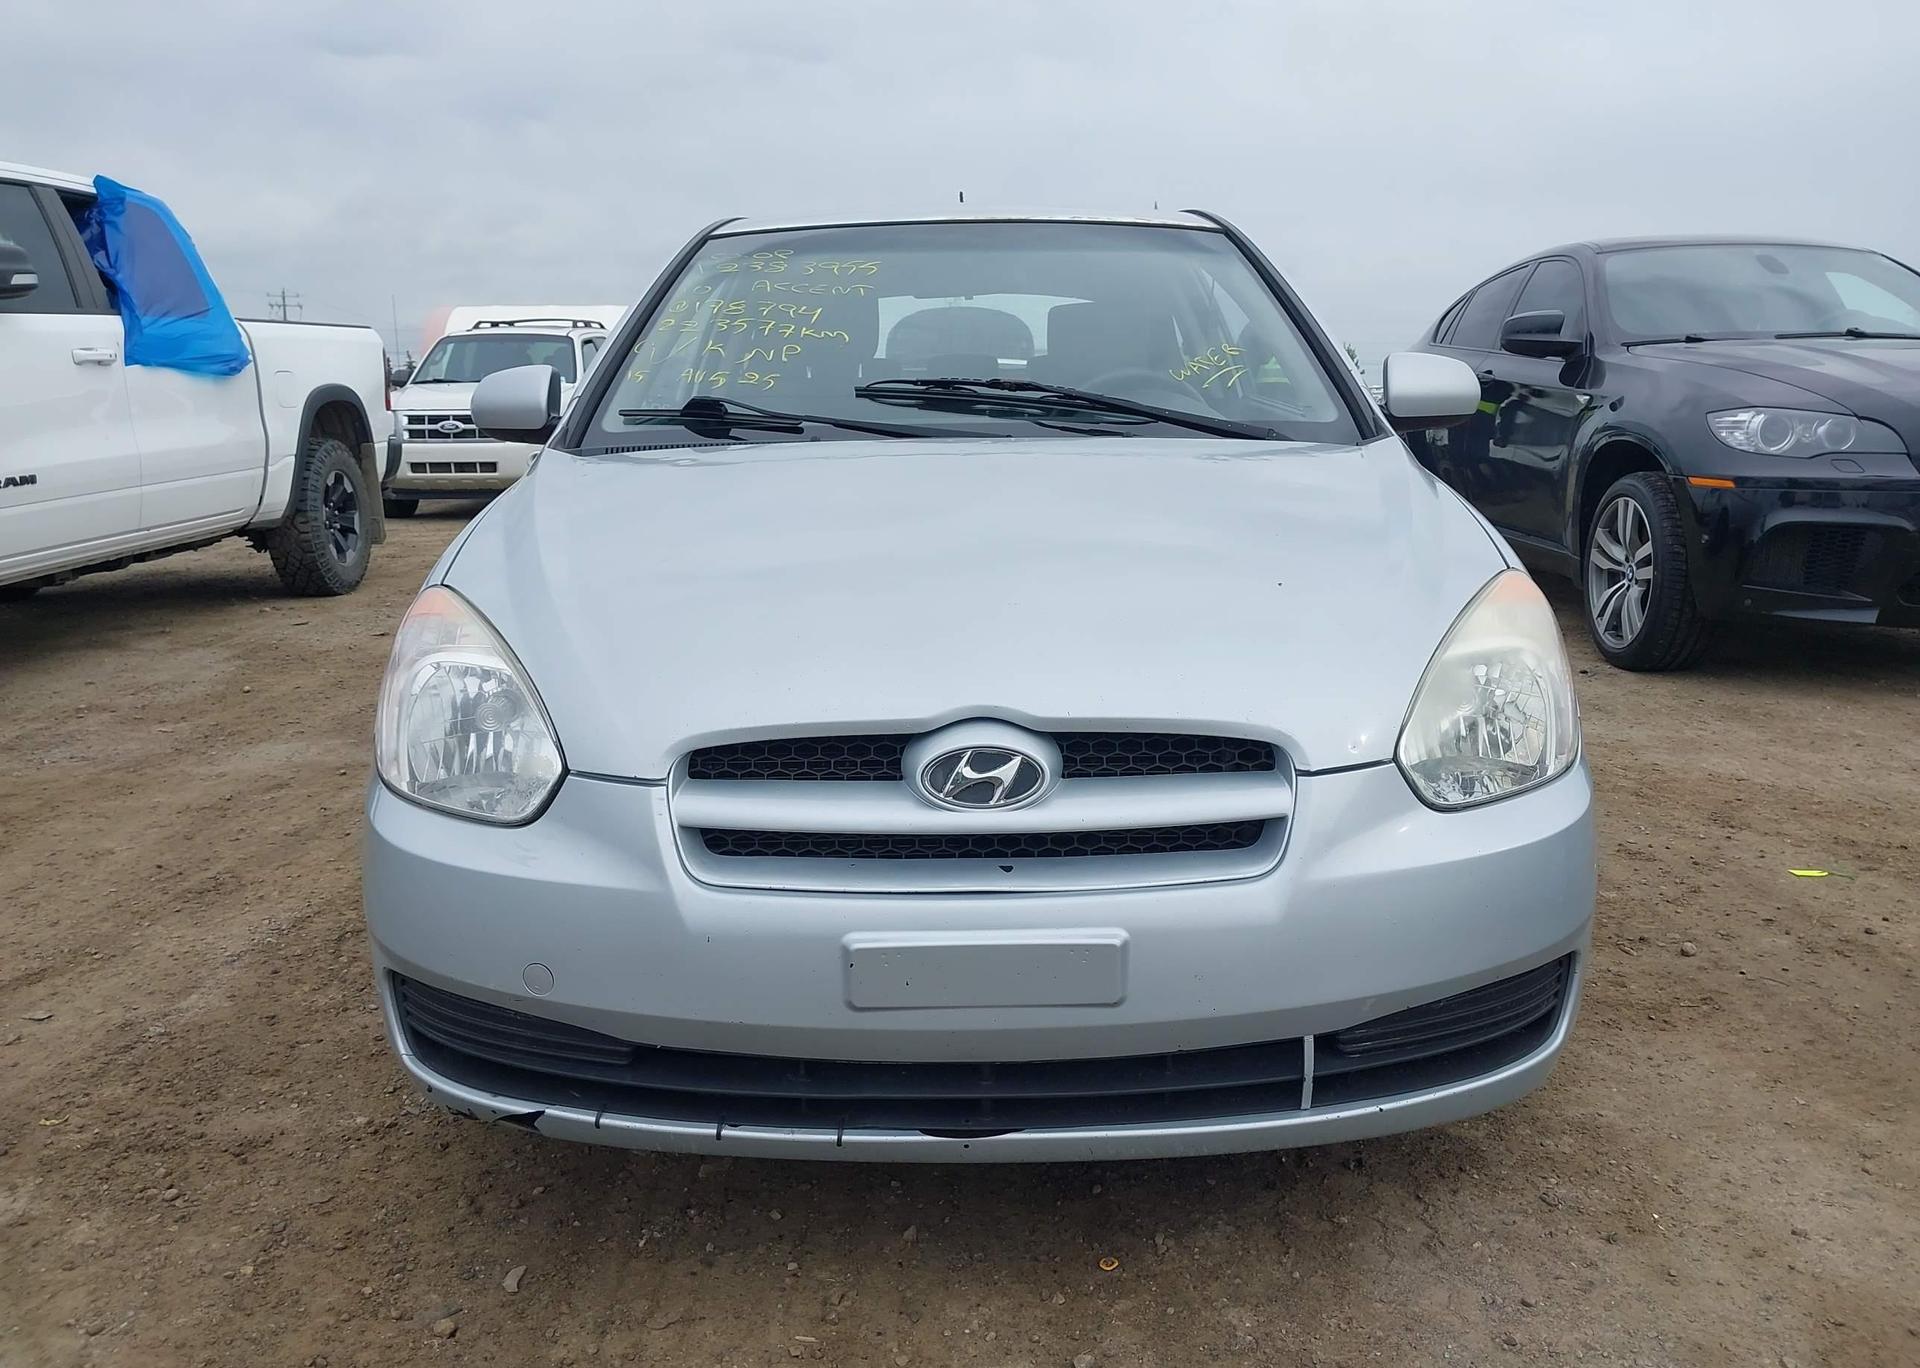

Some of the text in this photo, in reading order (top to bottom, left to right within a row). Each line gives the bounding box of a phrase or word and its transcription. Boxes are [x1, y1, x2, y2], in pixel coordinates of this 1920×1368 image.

[751, 279, 875, 296] ACCENT
[1168, 343, 1248, 381] WATER
[0, 474, 38, 489] AM
